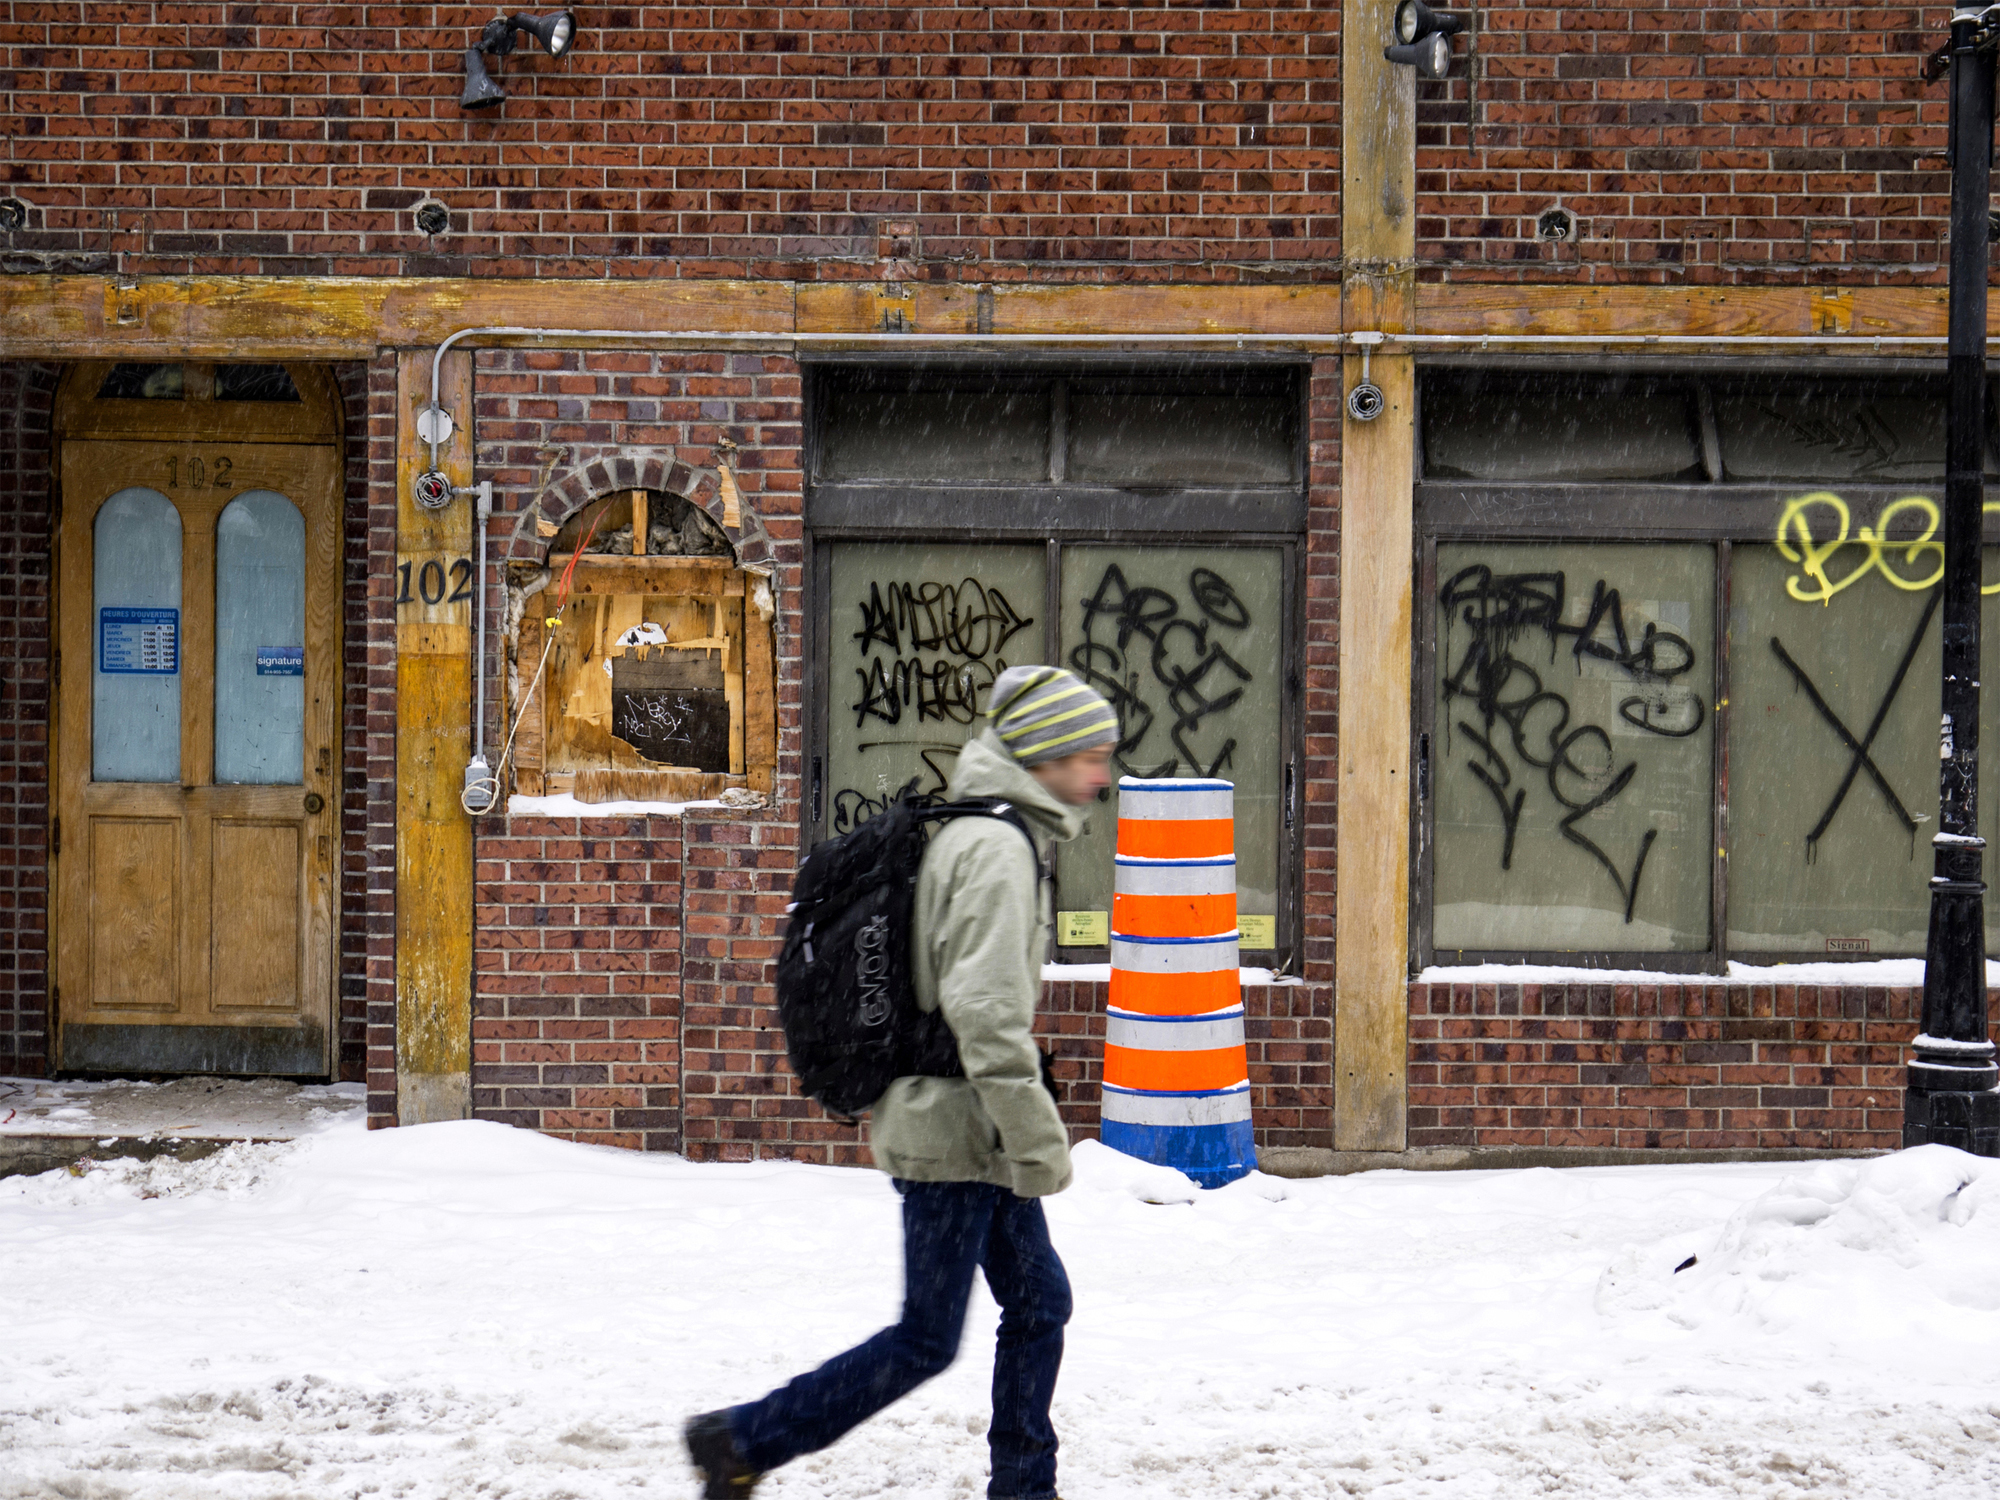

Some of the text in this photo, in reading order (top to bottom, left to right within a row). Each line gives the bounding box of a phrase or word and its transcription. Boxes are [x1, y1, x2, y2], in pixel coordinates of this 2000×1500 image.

[166, 457, 233, 489] 102
[396, 558, 474, 605] 102
[103, 610, 129, 618] HEURES
[257, 656, 302, 667] signature
[1830, 940, 1866, 950] Signal
